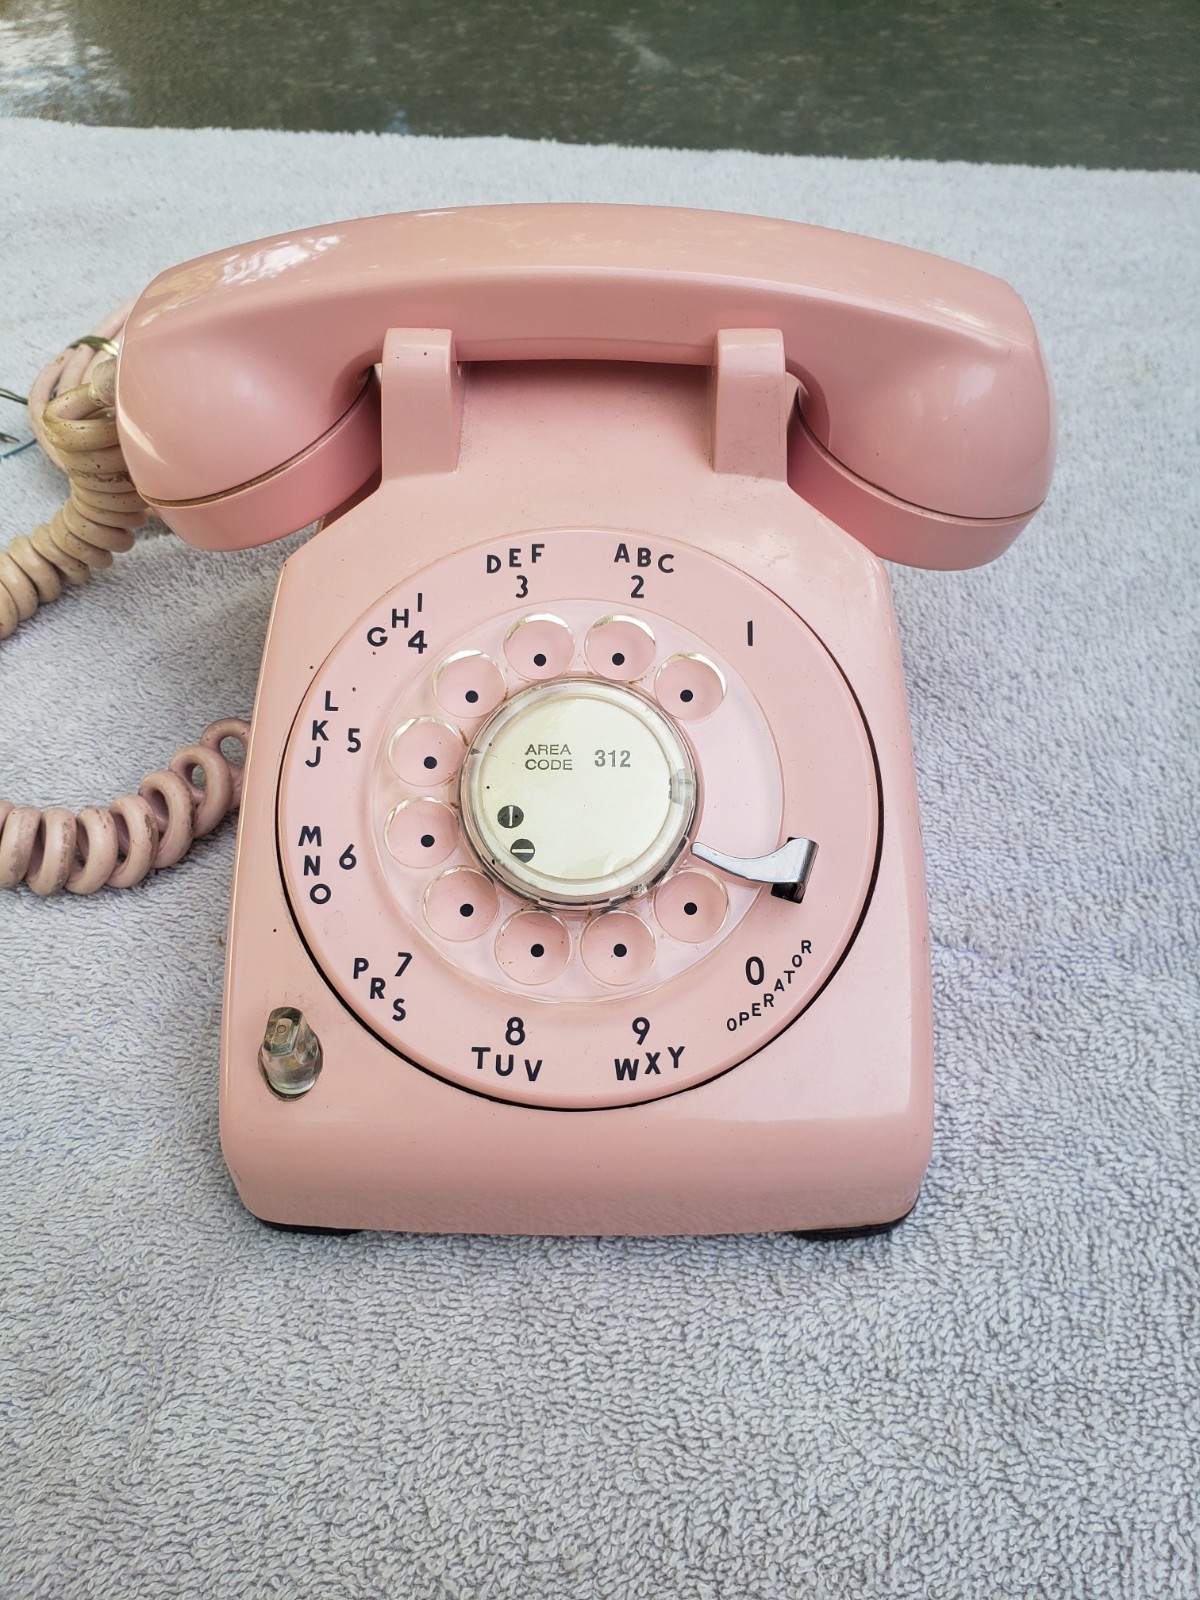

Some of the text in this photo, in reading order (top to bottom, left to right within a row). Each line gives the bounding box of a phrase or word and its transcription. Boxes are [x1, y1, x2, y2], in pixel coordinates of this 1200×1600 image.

[486, 543, 546, 574] DEF
[613, 543, 675, 574] ABC
[515, 574, 529, 599] 3
[630, 574, 646, 599] 2
[366, 592, 423, 648] GHI
[407, 629, 428, 655] 4
[346, 727, 362, 754] 5
[524, 743, 572, 756] AREA
[524, 759, 573, 771] CODE
[594, 749, 631, 768] 312
[298, 825, 332, 905] MNO
[338, 843, 357, 871] 6
[395, 951, 413, 977] 7
[353, 957, 407, 1022] PRS
[726, 939, 812, 1033] OPERATOR
[504, 1016, 526, 1046] 8
[631, 1016, 651, 1046] 9
[471, 1046, 543, 1082] TUV
[614, 1045, 686, 1081] WXY
